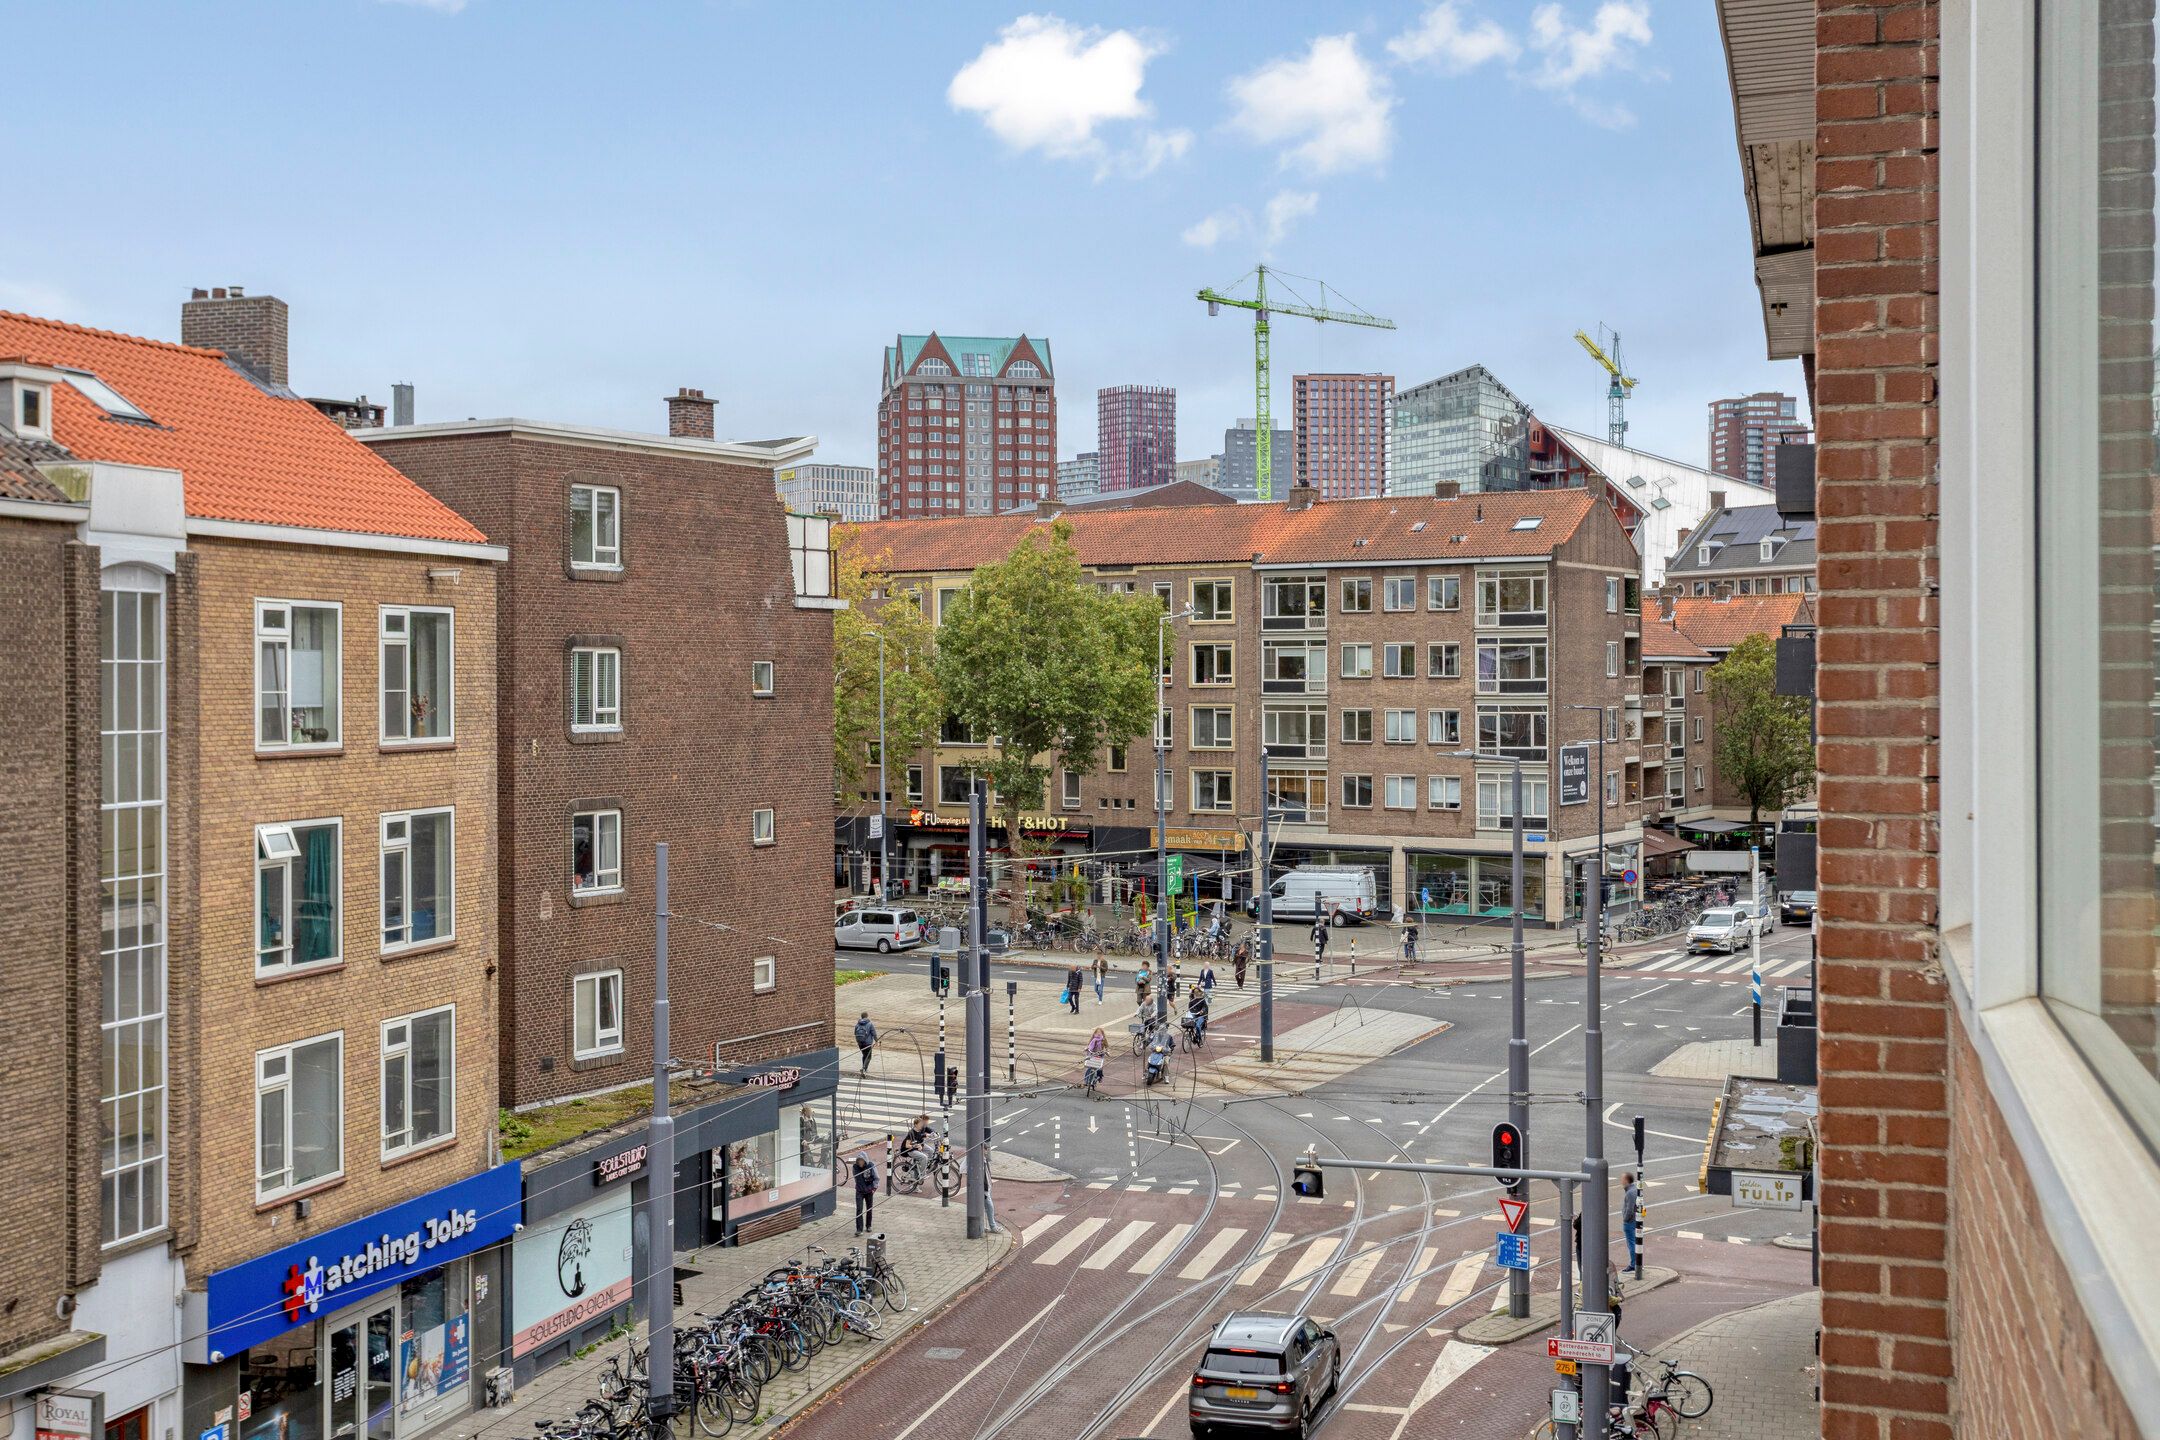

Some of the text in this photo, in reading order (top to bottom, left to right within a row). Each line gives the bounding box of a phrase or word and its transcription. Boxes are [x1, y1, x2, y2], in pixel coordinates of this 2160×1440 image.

[925, 811, 937, 826] FU
[937, 816, 962, 826] Dumplings
[600, 1145, 647, 1175] SOULSTUDIO
[1740, 1188, 1794, 1201] TULIP
[425, 1209, 476, 1249] Jobs
[1559, 1349, 1595, 1358] Barendrecht
[1556, 1362, 1570, 1373] 275
[45, 1402, 88, 1421] ROYAL
